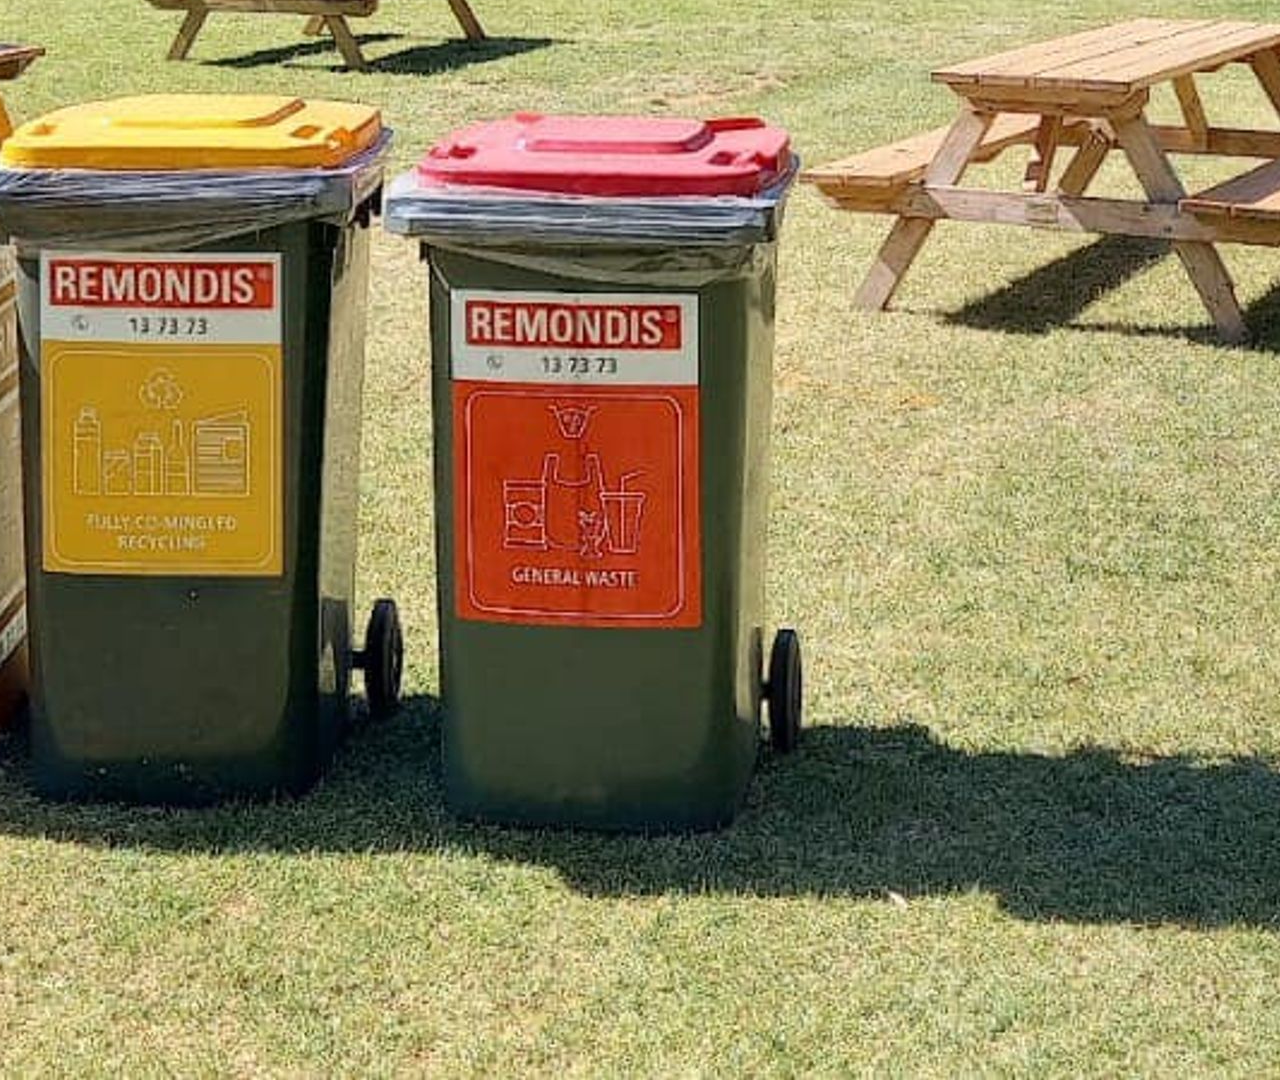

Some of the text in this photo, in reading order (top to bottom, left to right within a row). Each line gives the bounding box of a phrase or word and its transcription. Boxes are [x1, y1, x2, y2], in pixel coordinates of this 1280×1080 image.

[129, 317, 207, 335] 13 73 73
[542, 356, 618, 374] 13 73 73
[512, 566, 639, 587] GENERAL WASTE
